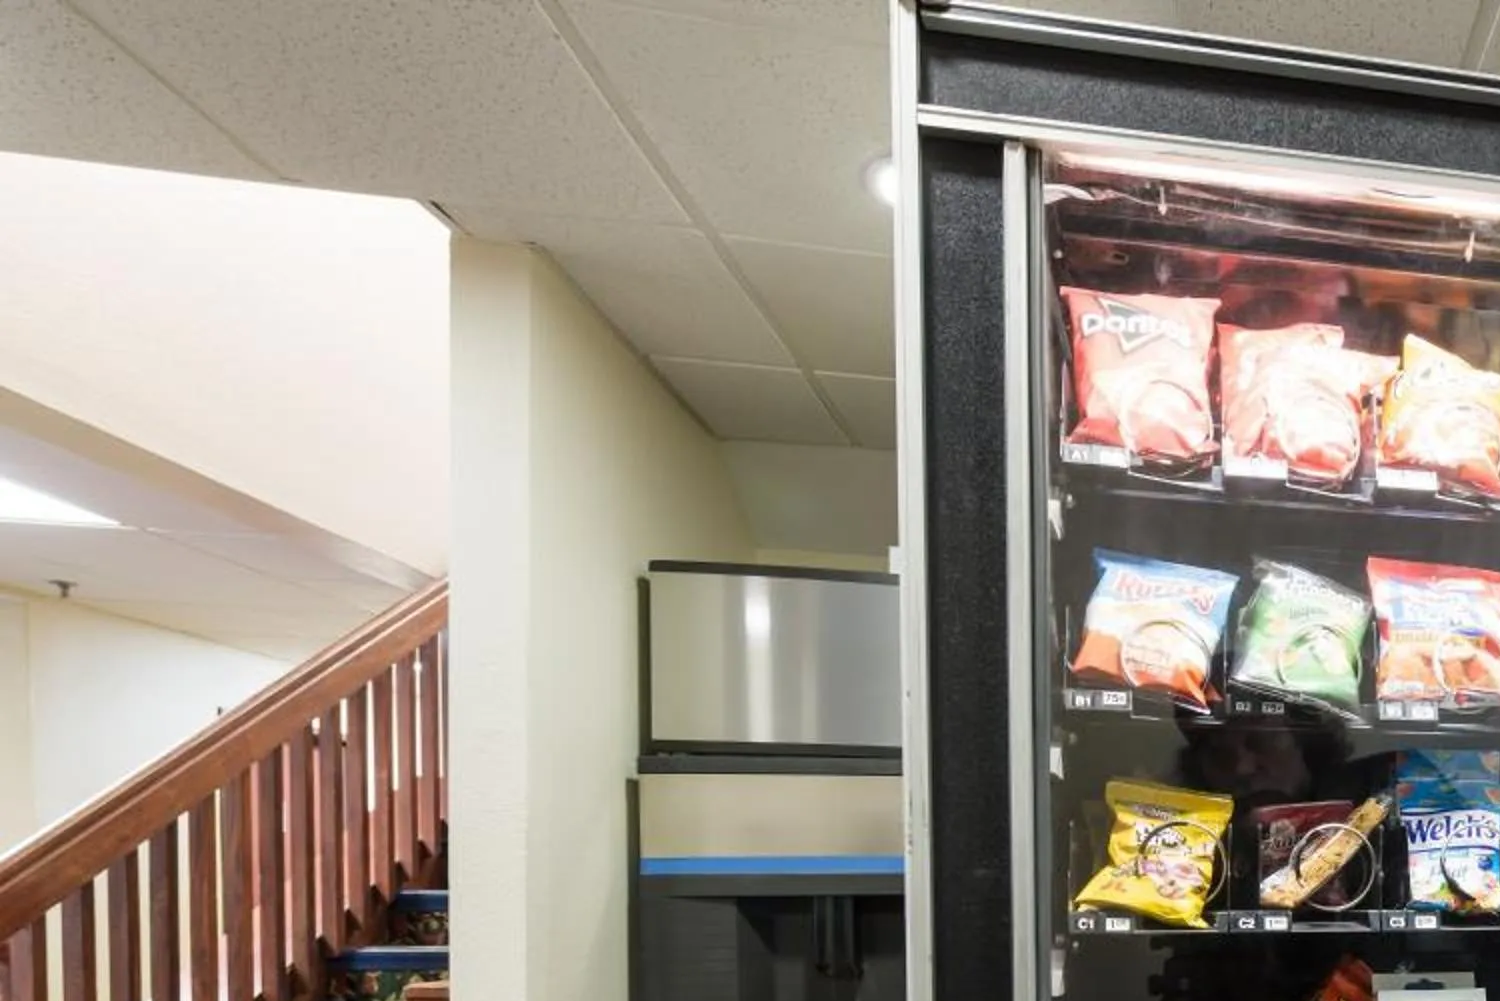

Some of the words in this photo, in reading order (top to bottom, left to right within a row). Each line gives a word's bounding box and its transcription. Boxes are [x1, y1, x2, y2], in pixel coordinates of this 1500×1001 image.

[1071, 450, 1088, 461] A1
[1075, 694, 1091, 706] B1
[1404, 815, 1498, 845] Welch's
[1078, 917, 1094, 929] C1
[1239, 917, 1255, 929] C2
